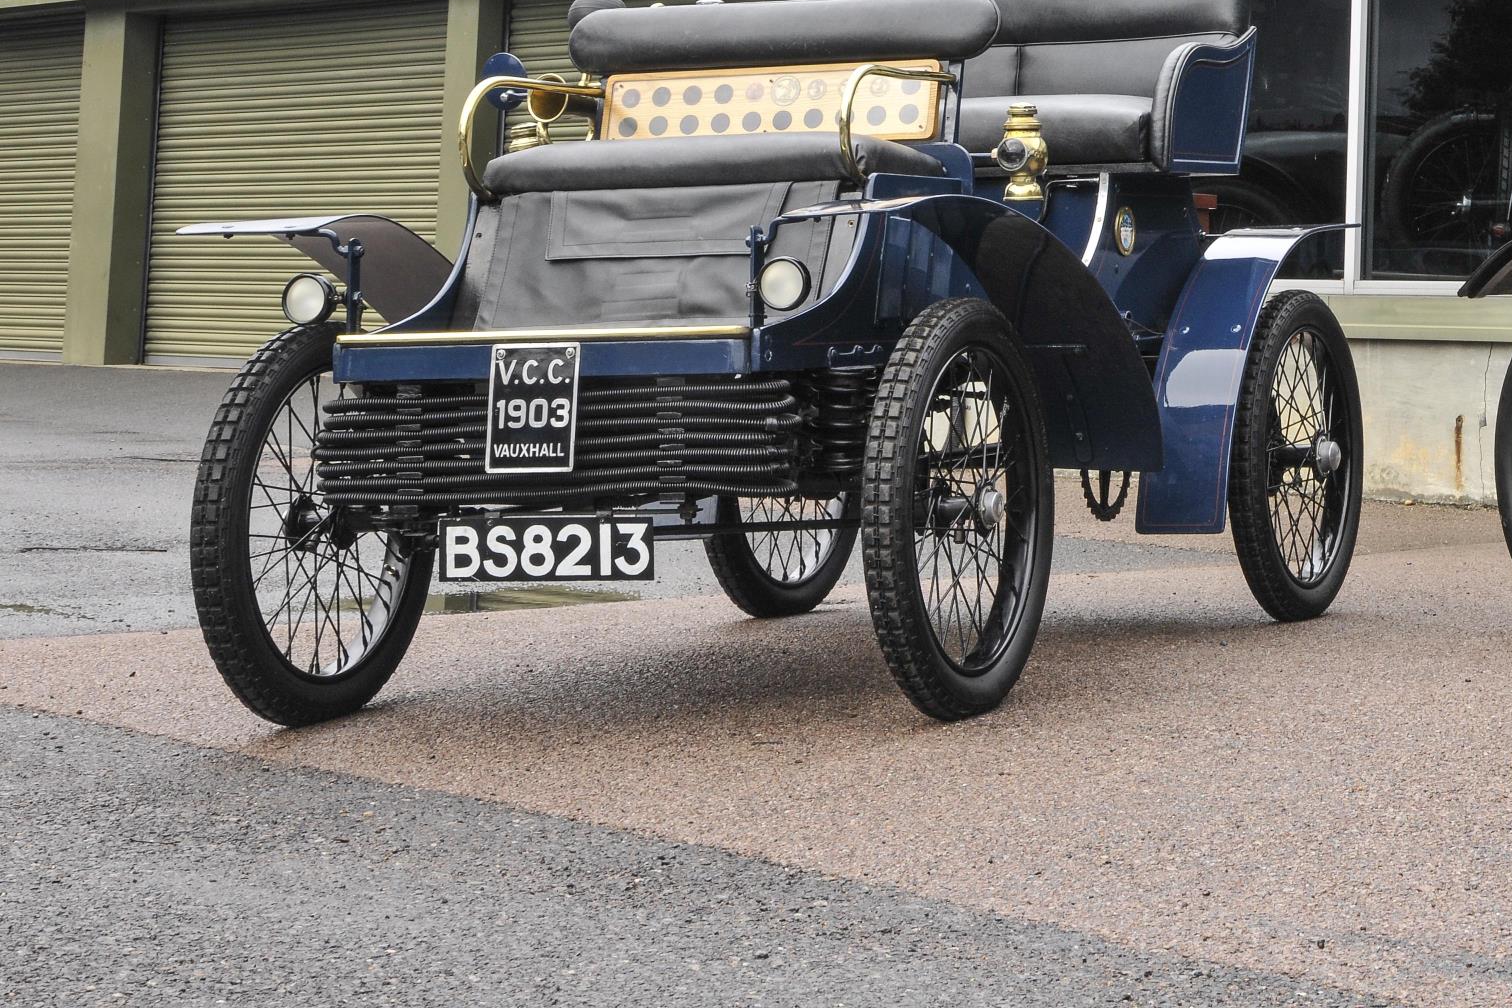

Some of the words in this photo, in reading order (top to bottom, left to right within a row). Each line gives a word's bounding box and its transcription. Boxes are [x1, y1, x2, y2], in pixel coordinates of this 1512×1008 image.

[495, 358, 571, 386] V.C.C.
[496, 398, 571, 430] 1903
[493, 442, 565, 459] VAUXHALL
[445, 523, 650, 579] BS8213
